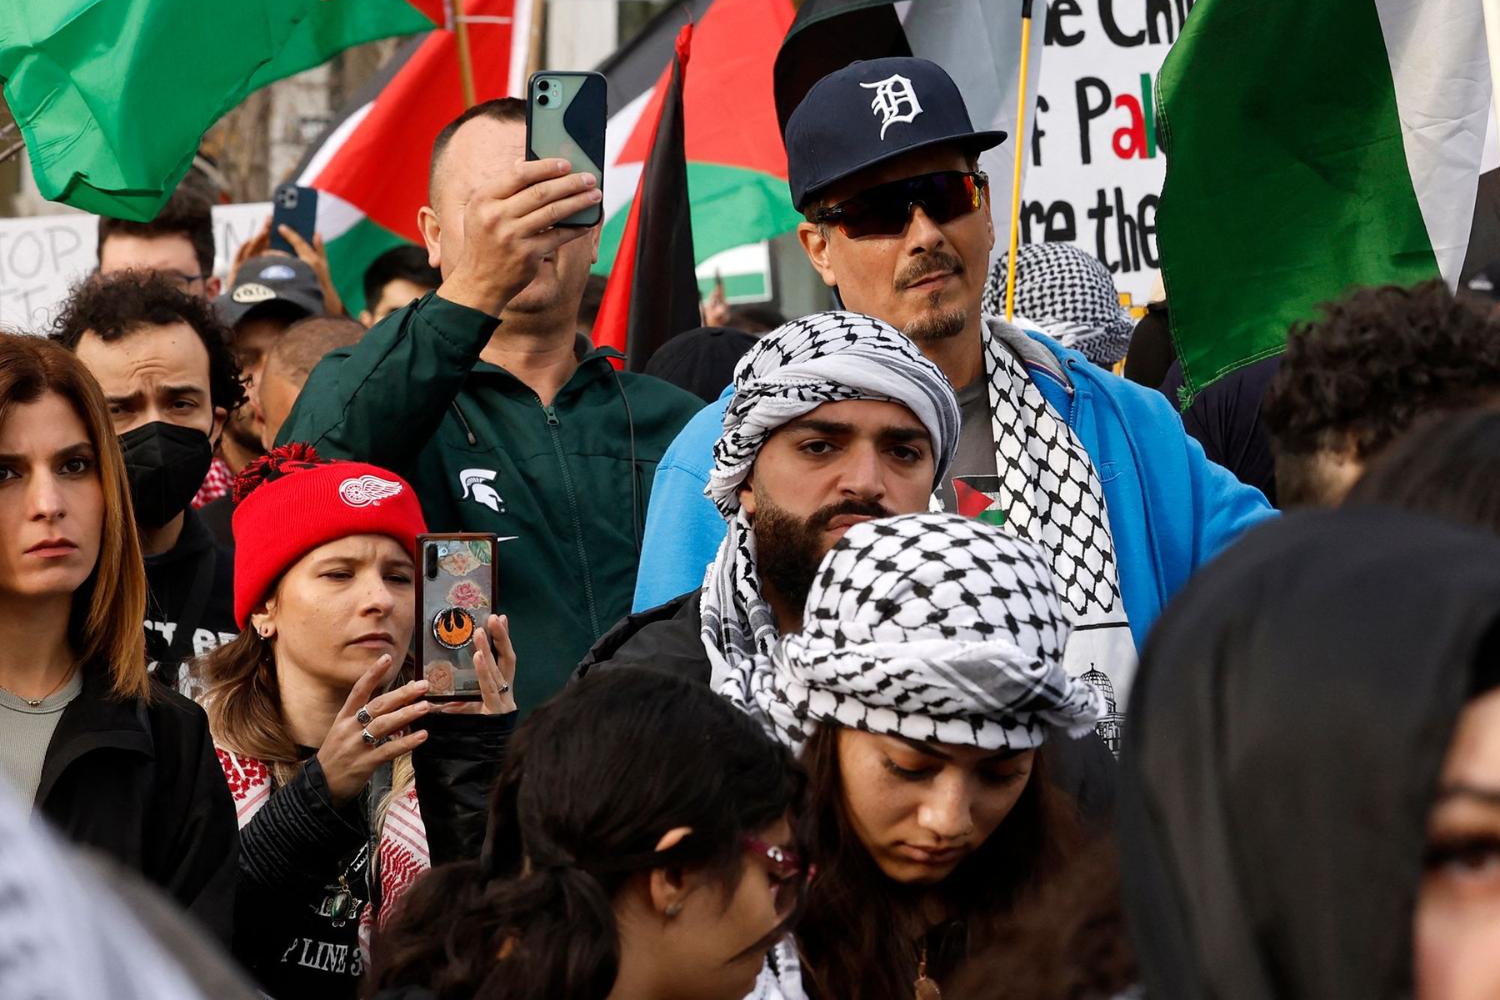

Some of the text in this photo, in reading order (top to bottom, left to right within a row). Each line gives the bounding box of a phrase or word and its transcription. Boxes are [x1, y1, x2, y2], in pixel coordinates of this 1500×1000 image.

[859, 73, 924, 141] D
[1075, 72, 1166, 165] Pal
[1017, 199, 1076, 244] re
[297, 937, 349, 973] LINE
